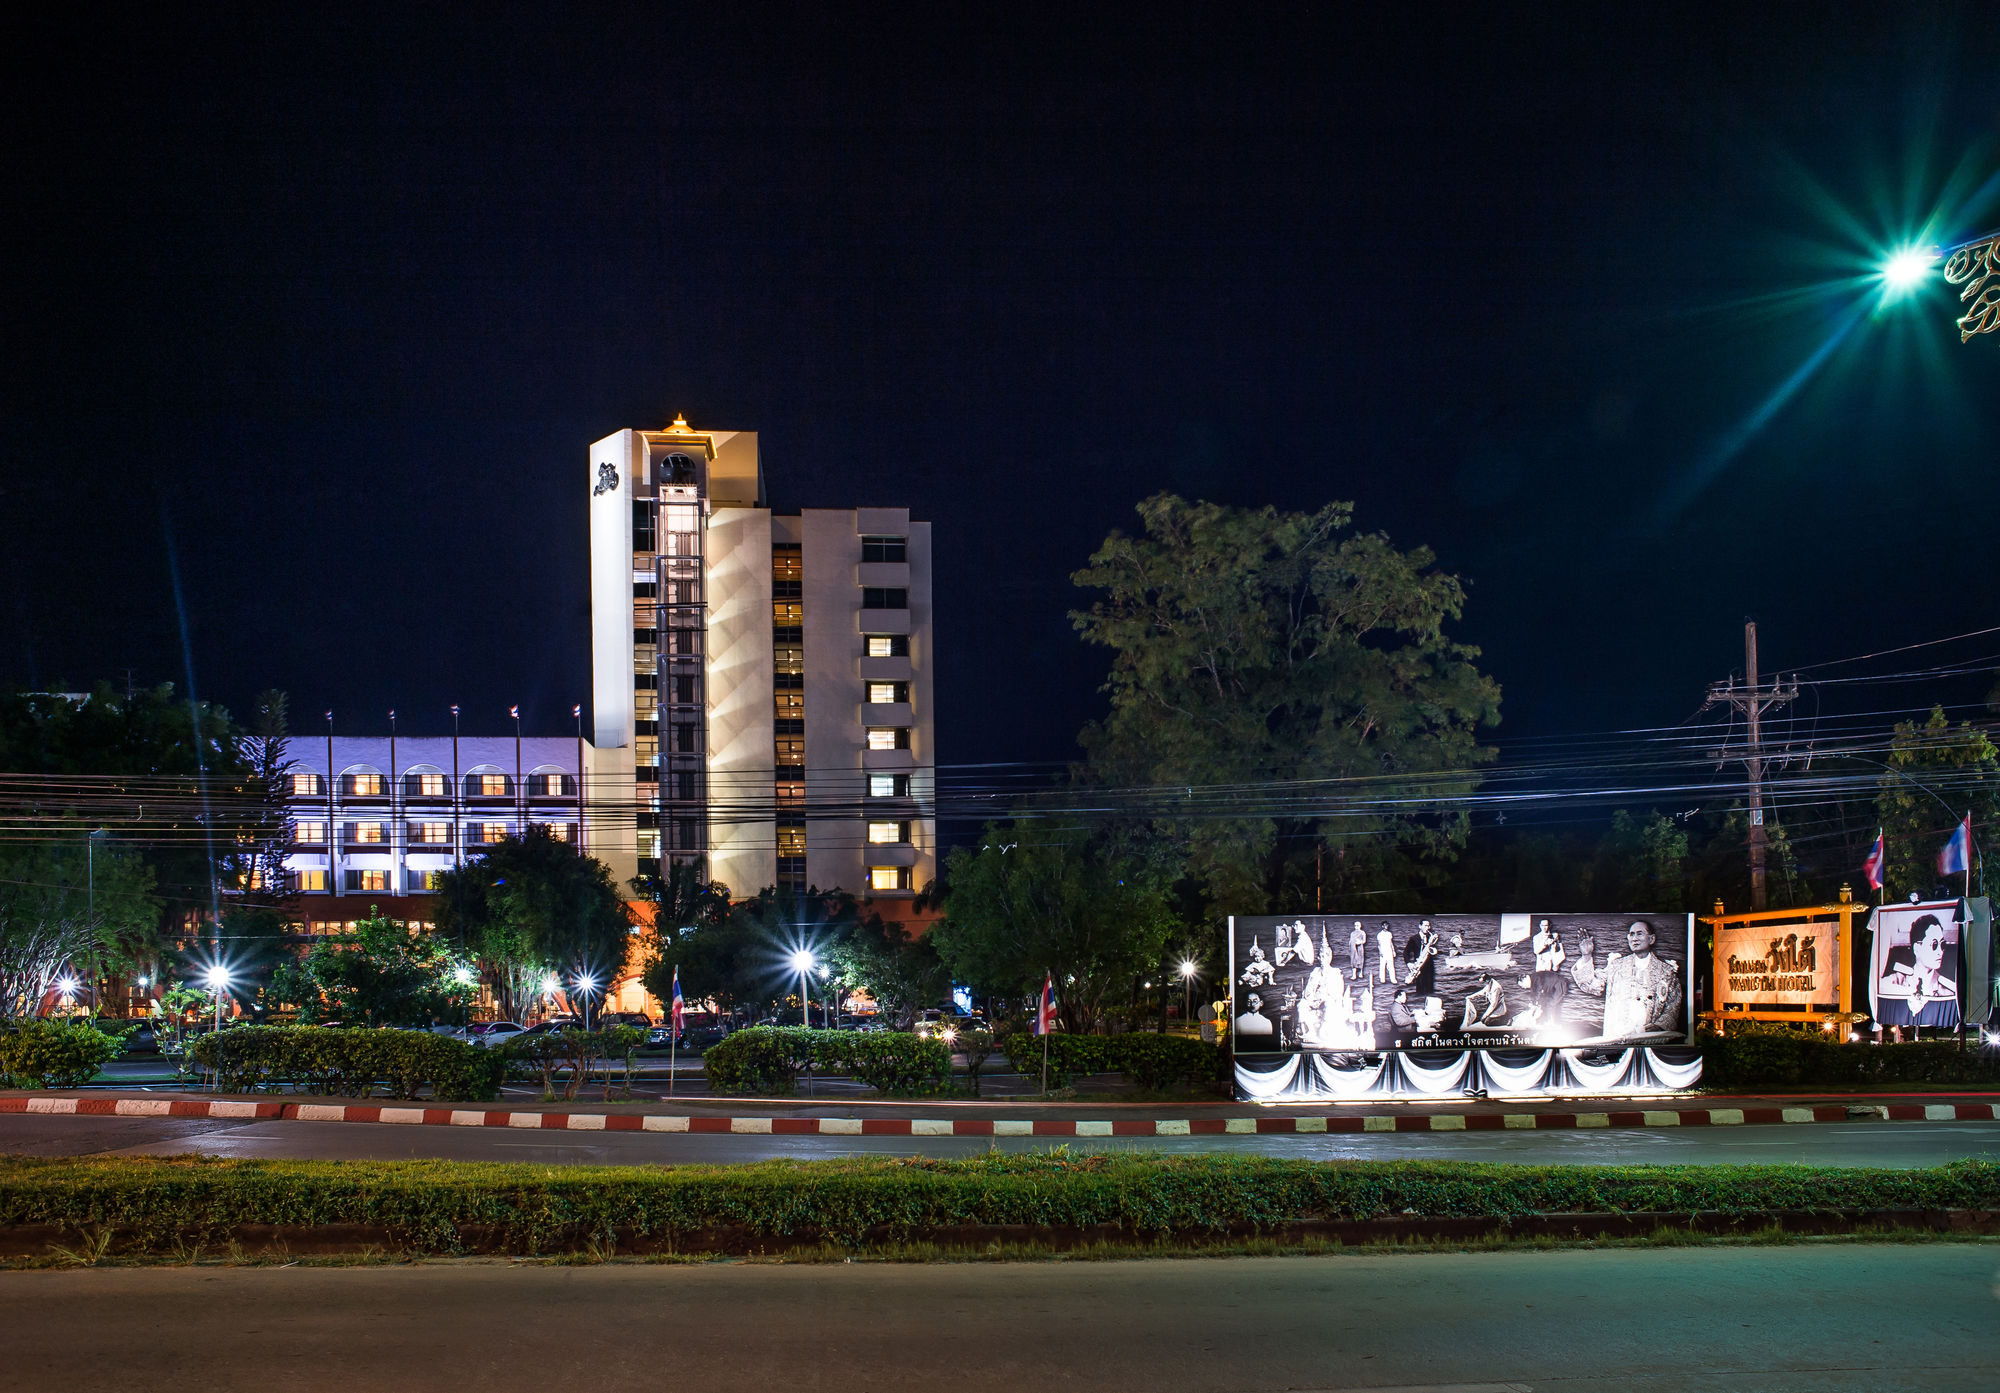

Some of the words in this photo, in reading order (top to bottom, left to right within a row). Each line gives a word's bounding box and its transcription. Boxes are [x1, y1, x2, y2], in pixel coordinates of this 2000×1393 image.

[1728, 976, 1760, 992] WANG
[1760, 976, 1777, 991] TAI
[1778, 975, 1816, 992] HOTEL
